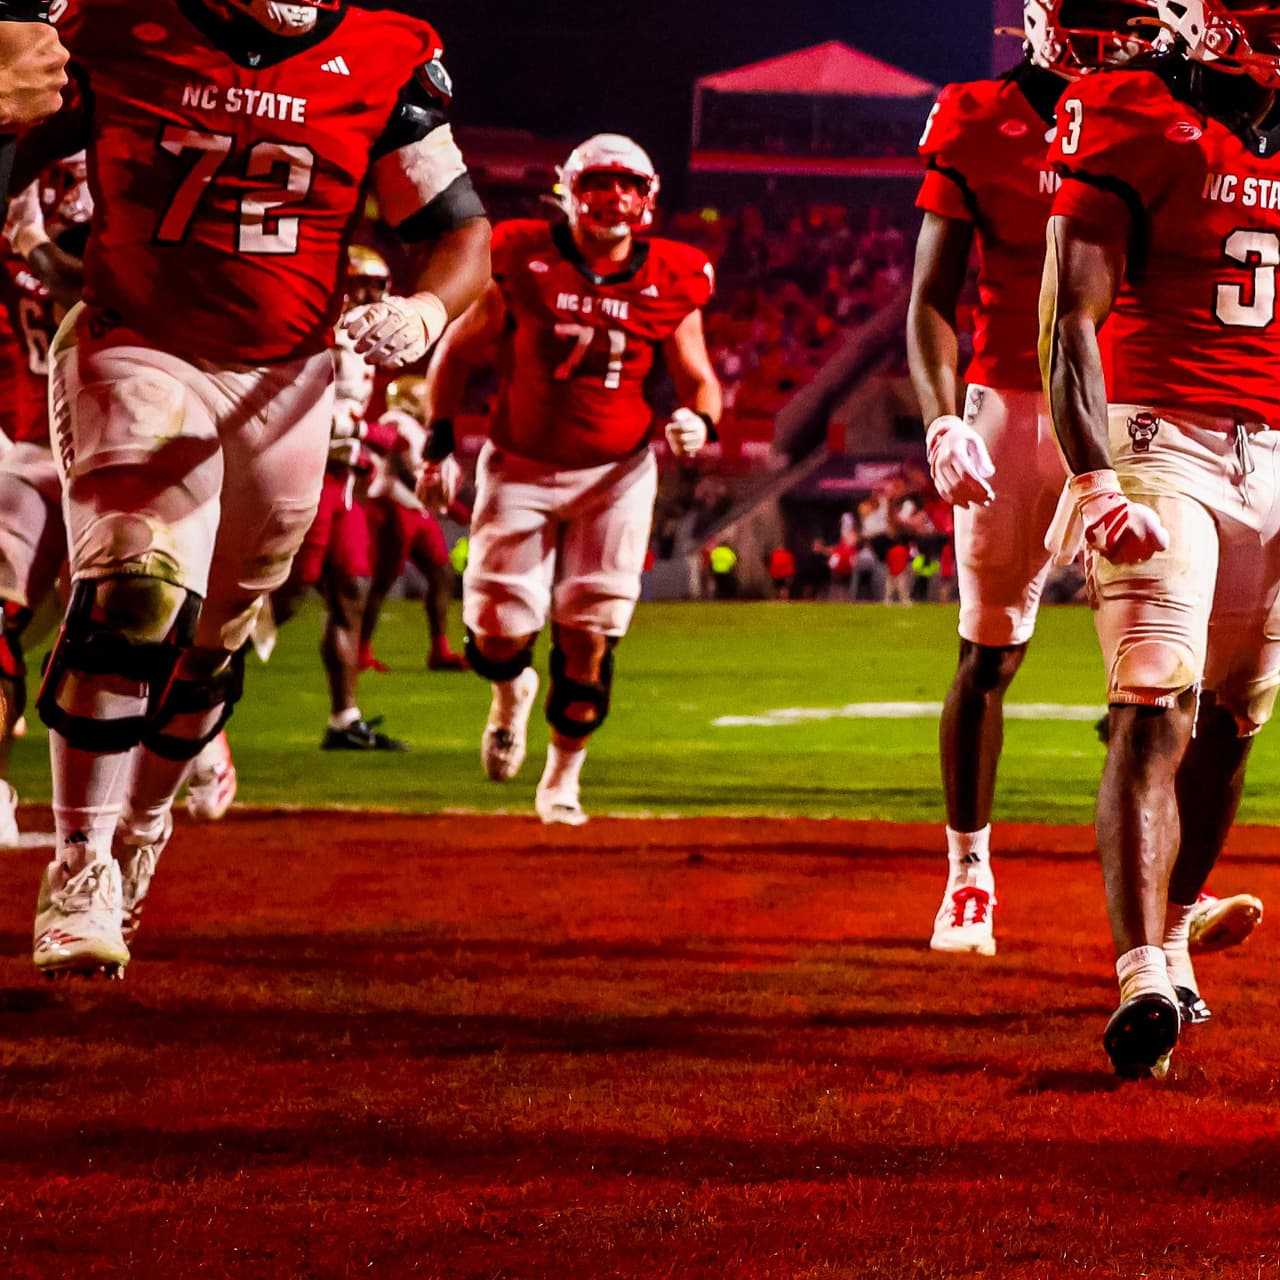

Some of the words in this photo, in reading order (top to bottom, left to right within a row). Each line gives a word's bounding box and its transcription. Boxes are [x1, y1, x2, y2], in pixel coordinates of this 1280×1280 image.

[181, 83, 219, 110] NC
[224, 86, 308, 124] STATE
[1060, 98, 1084, 155] 3
[154, 122, 316, 255] 72
[1201, 172, 1238, 203] NC
[581, 296, 629, 320] SATE
[553, 323, 627, 390] 71
